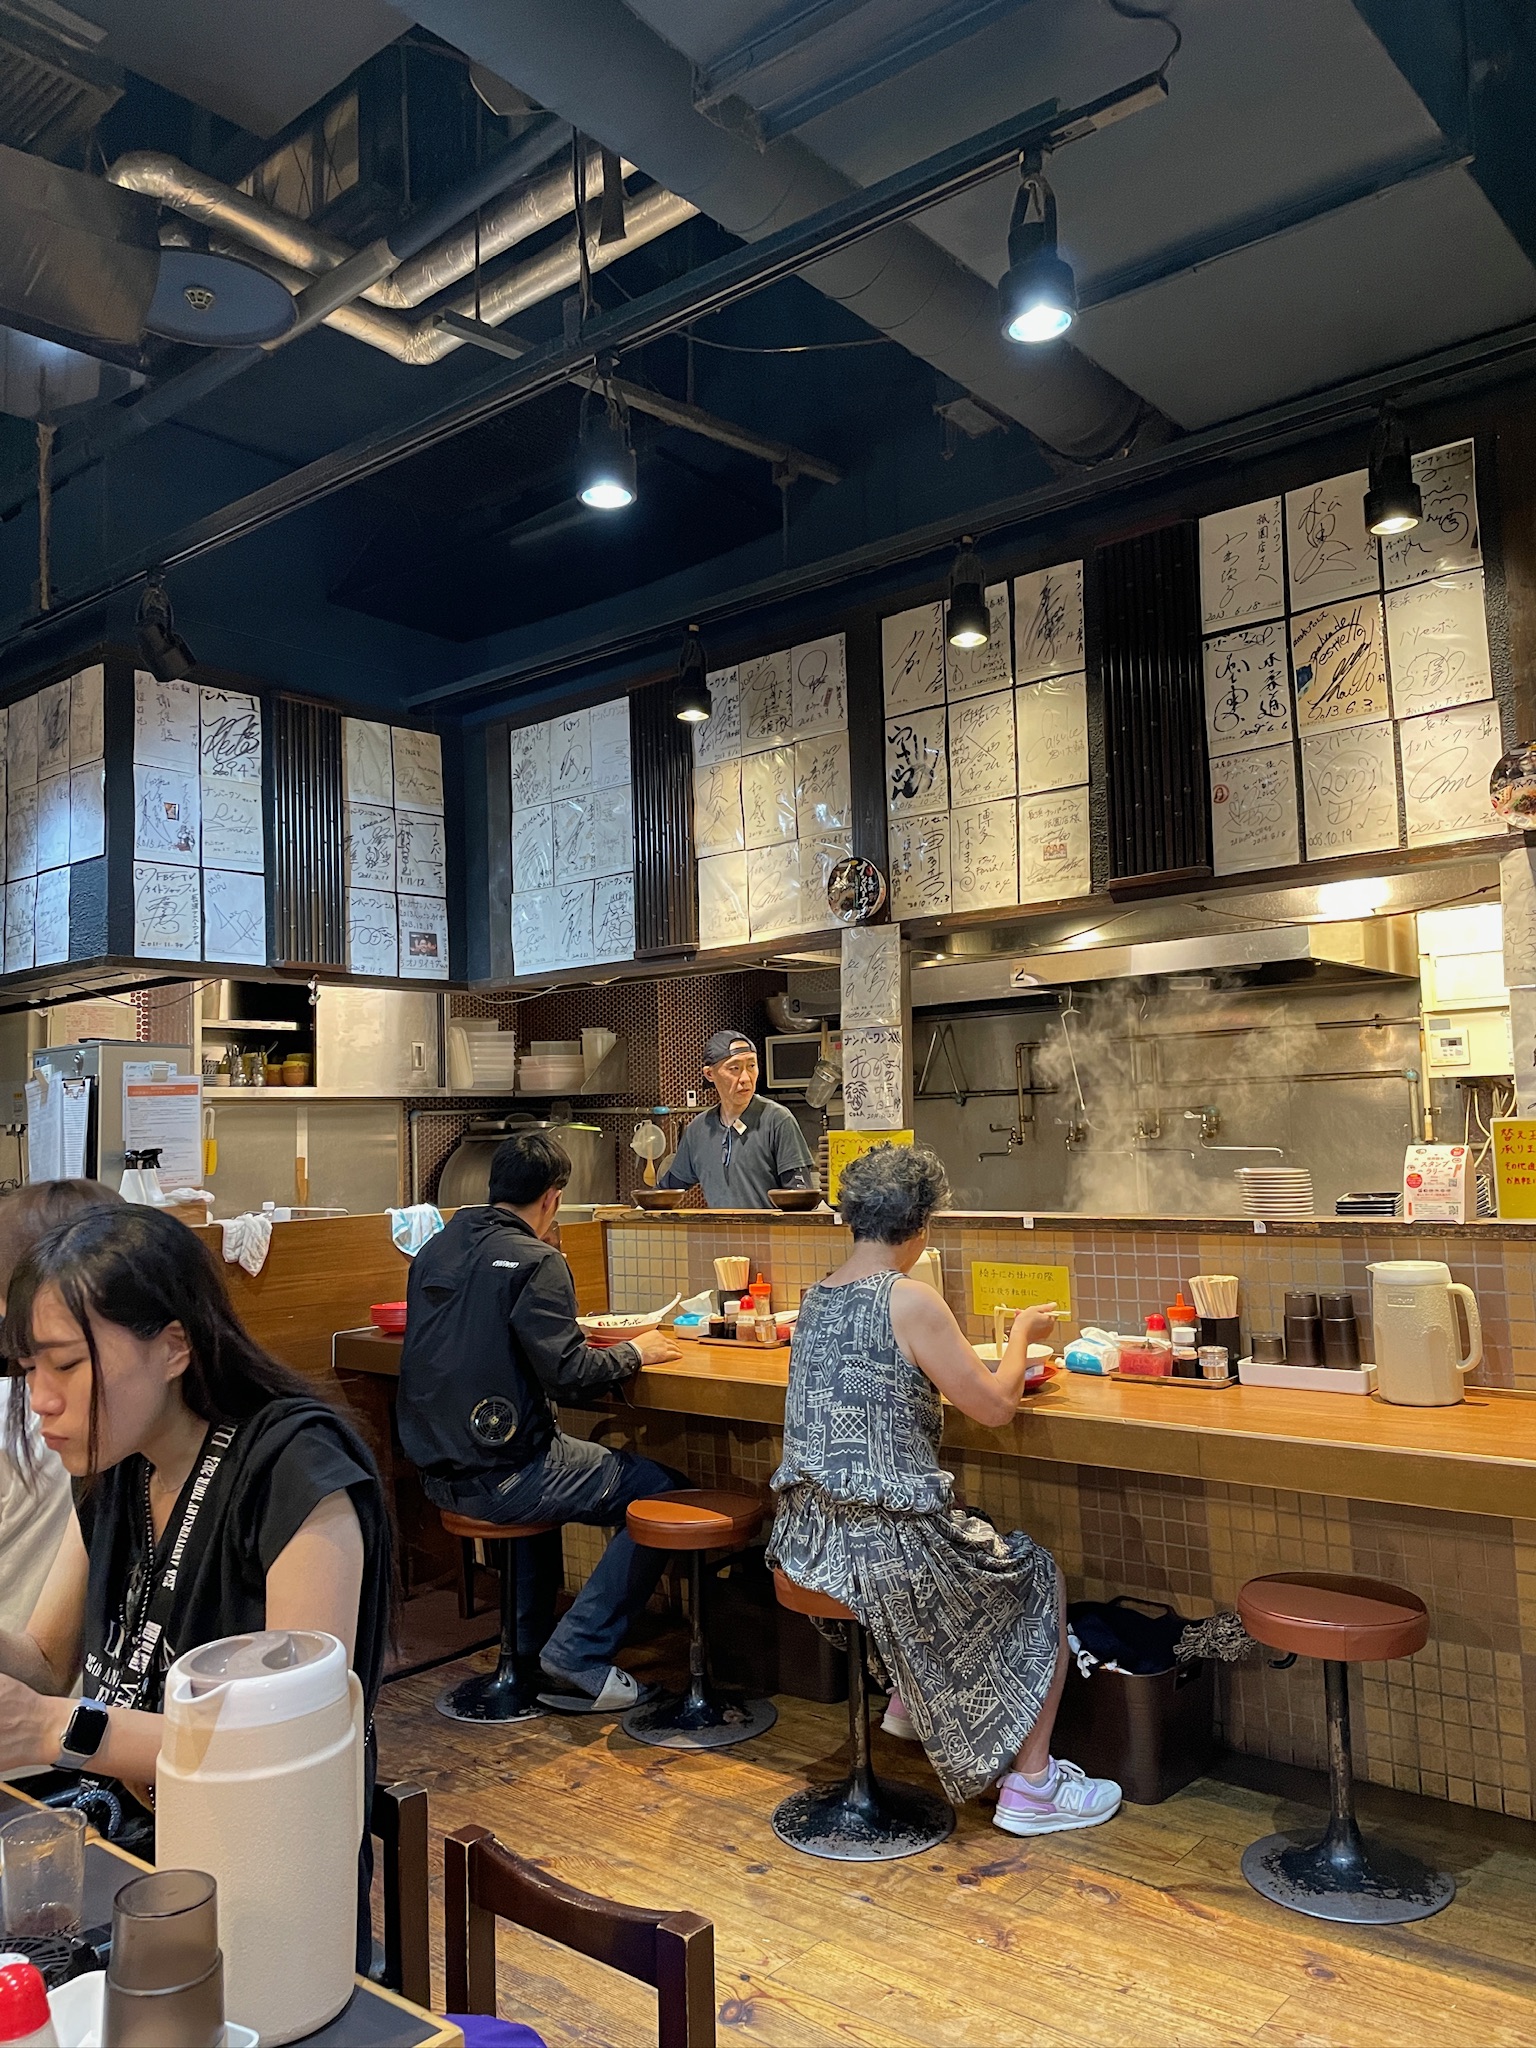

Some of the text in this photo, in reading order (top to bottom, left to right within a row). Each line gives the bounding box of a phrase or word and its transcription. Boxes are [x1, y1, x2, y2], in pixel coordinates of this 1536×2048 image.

[792, 999, 801, 1013] 3
[1420, 1159, 1451, 1168] スタンプ
[979, 1268, 1055, 1281] 椅子にお掛けの際
[200, 1455, 222, 1478] 2024
[190, 1476, 211, 1501] TOUR
[169, 1500, 200, 1568] ANNIVERSARY
